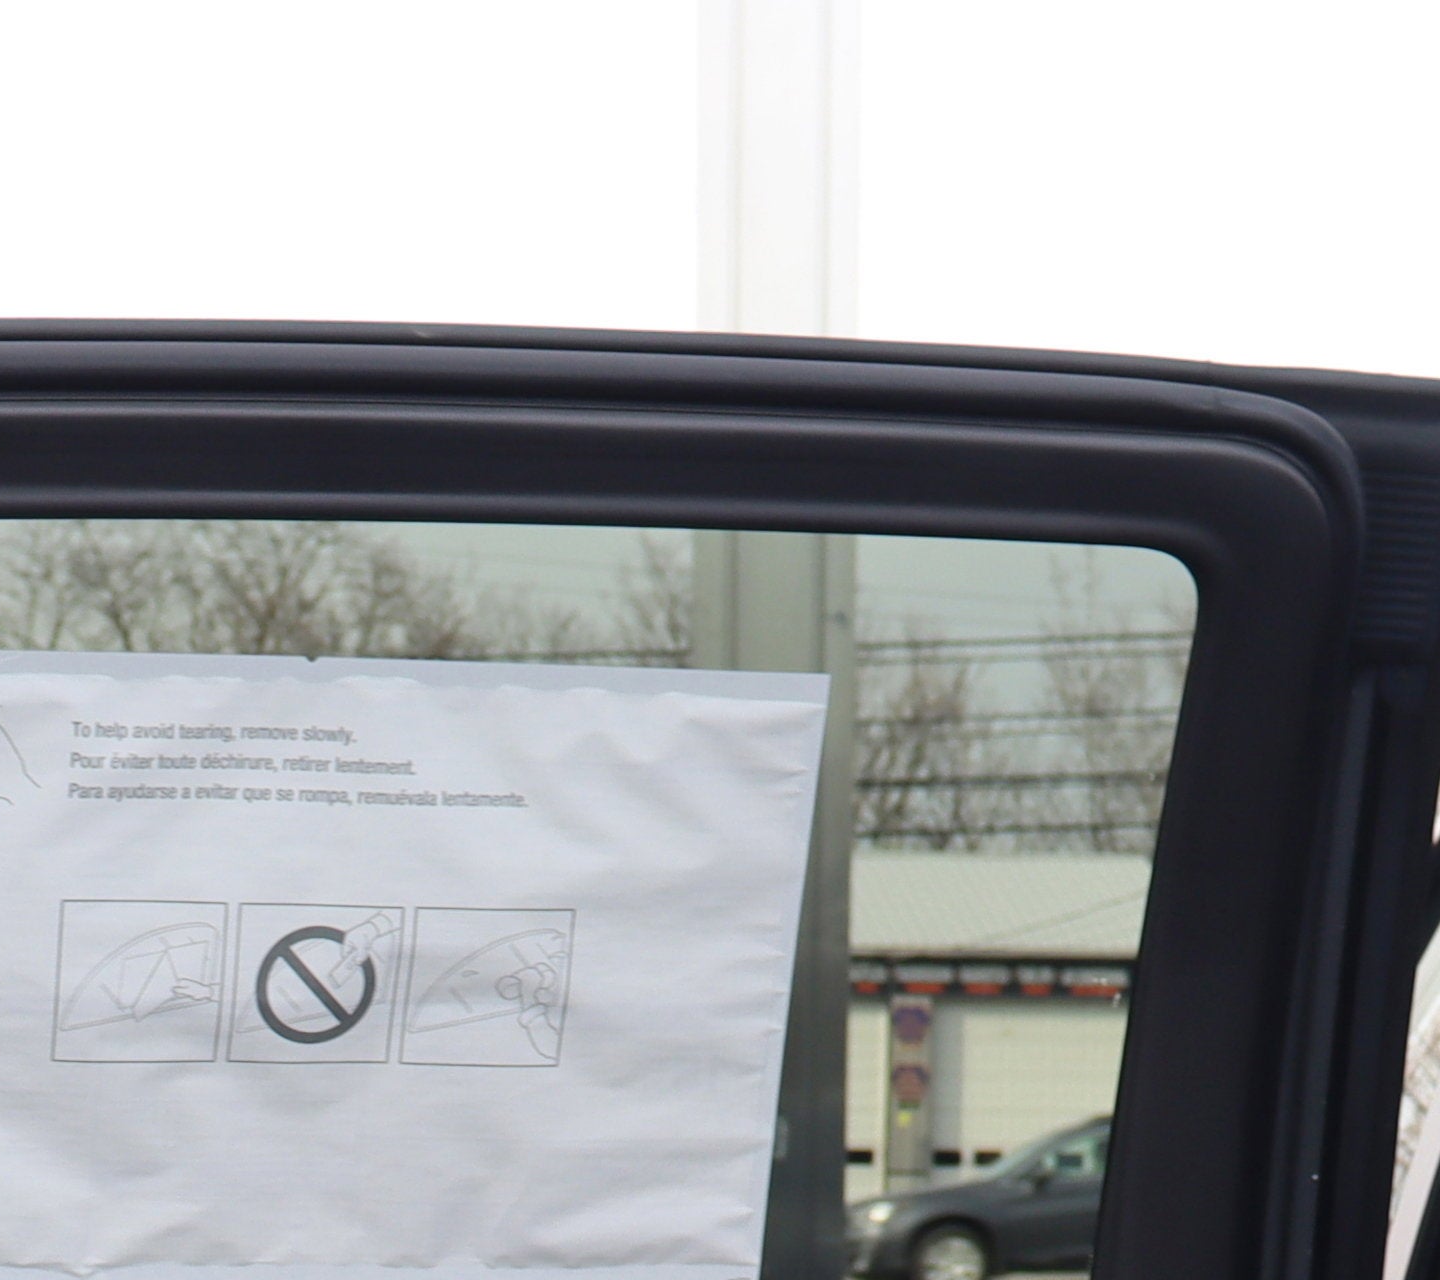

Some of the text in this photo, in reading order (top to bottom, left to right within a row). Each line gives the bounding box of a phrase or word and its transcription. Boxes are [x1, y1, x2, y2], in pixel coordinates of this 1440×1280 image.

[71, 721, 357, 746] To help avoid tearing, remove slowly.
[69, 751, 417, 776] Pour éviter toute déchirure, retirer lentement.
[68, 782, 103, 799] Para
[108, 783, 178, 802] ayudarse
[181, 786, 191, 800] a
[195, 783, 239, 800] evitar
[243, 786, 273, 803] que
[275, 787, 295, 801] se
[298, 789, 353, 806] rompa,
[441, 791, 529, 808] lentamente.
